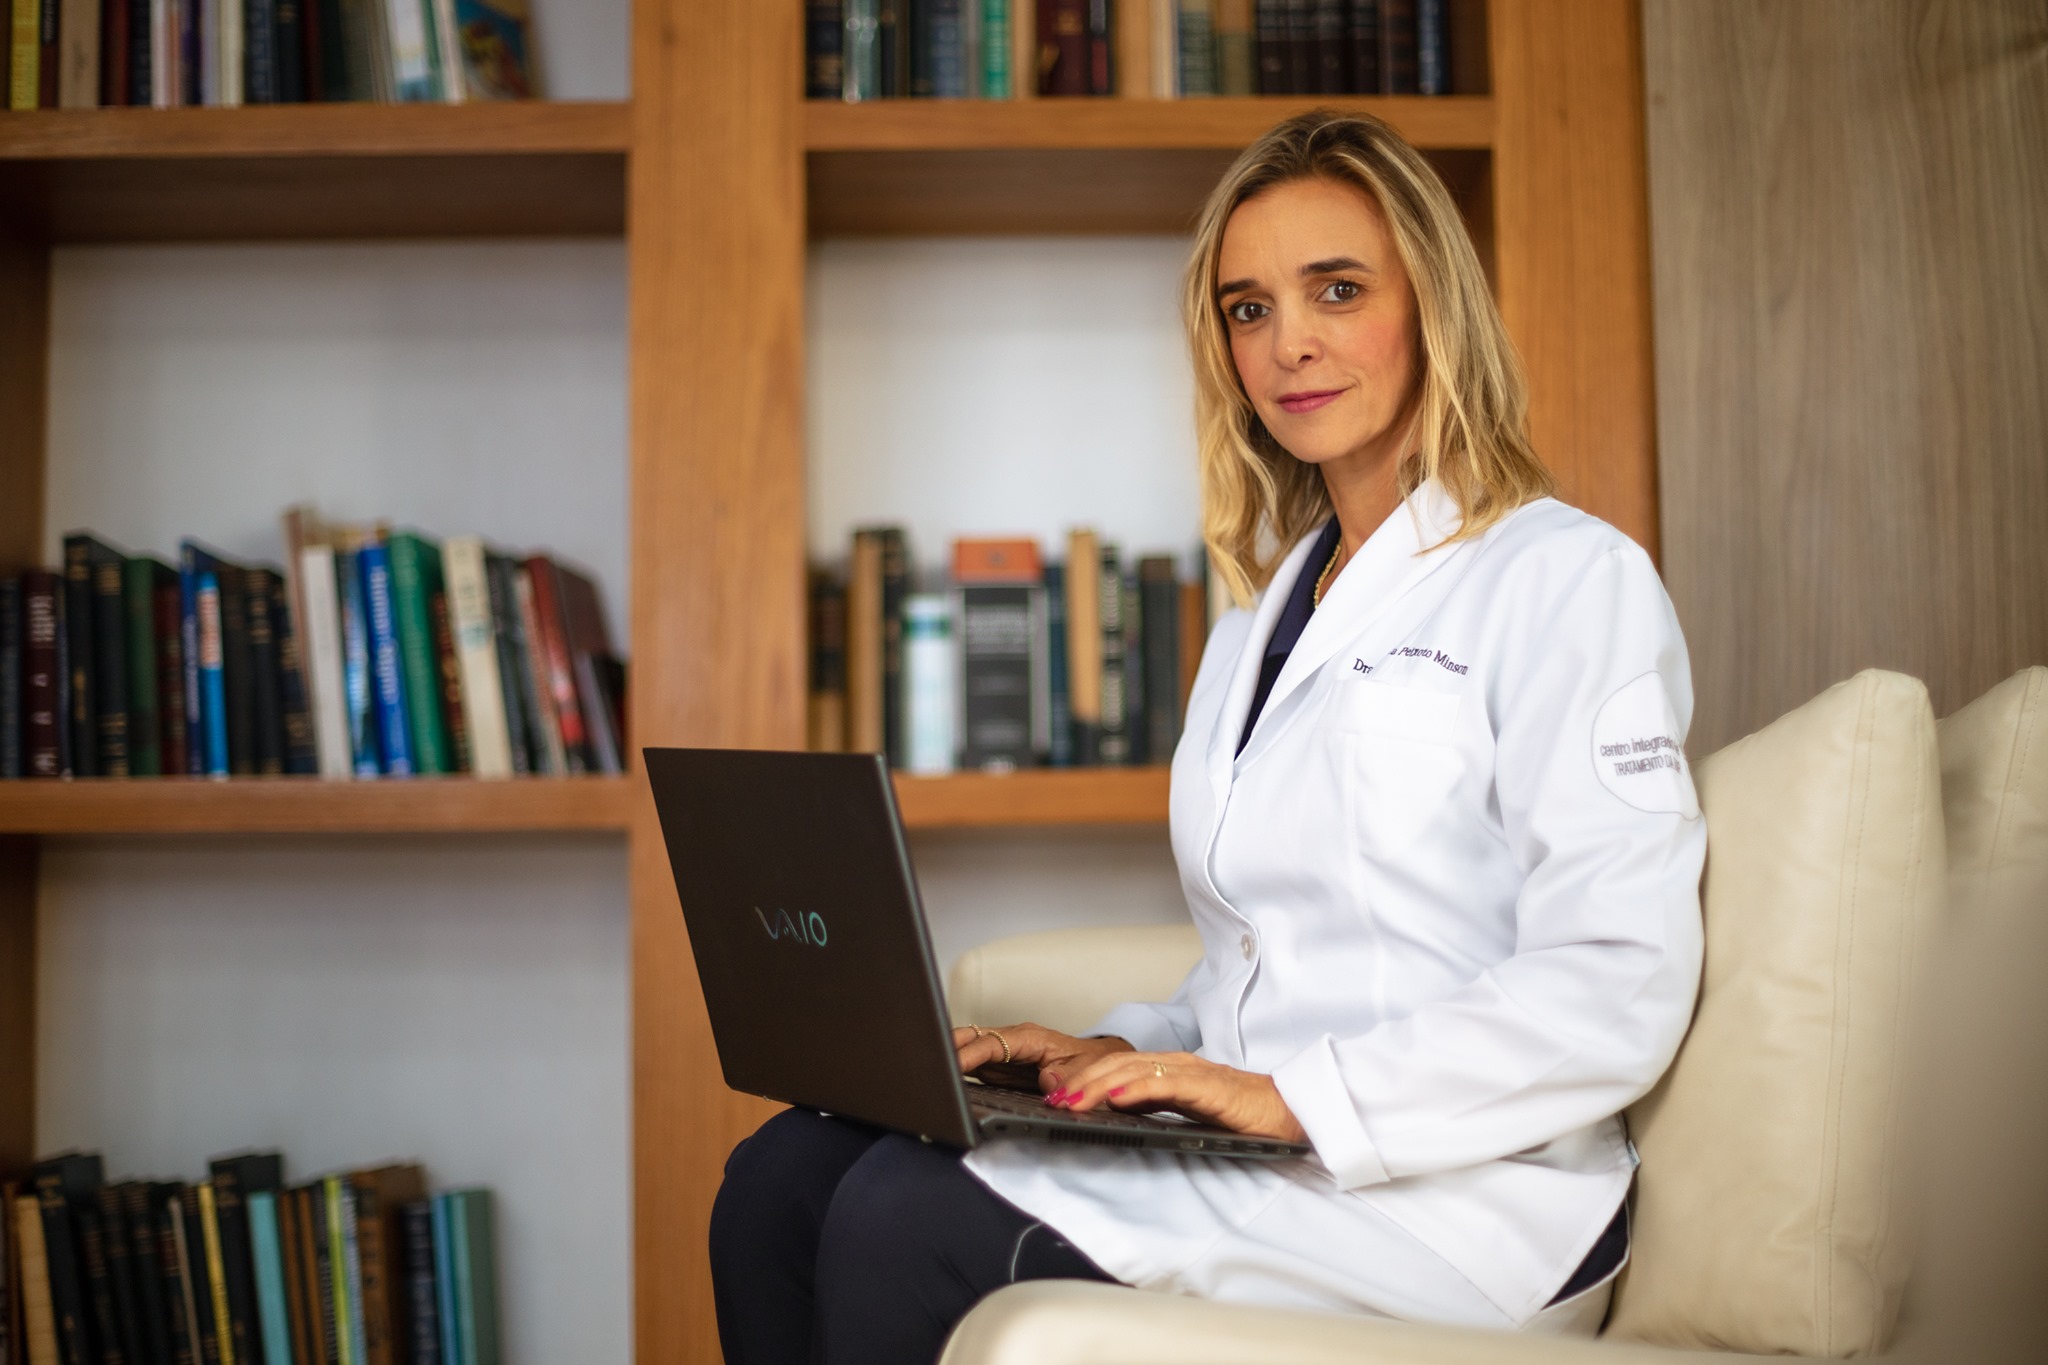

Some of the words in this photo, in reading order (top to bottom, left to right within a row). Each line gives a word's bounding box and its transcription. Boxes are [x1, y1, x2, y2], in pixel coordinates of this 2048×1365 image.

[1600, 742, 1631, 757] centro
[1631, 736, 1674, 754] integra
[1614, 755, 1664, 776] TRATAMENTO
[754, 905, 828, 948] VAIO
